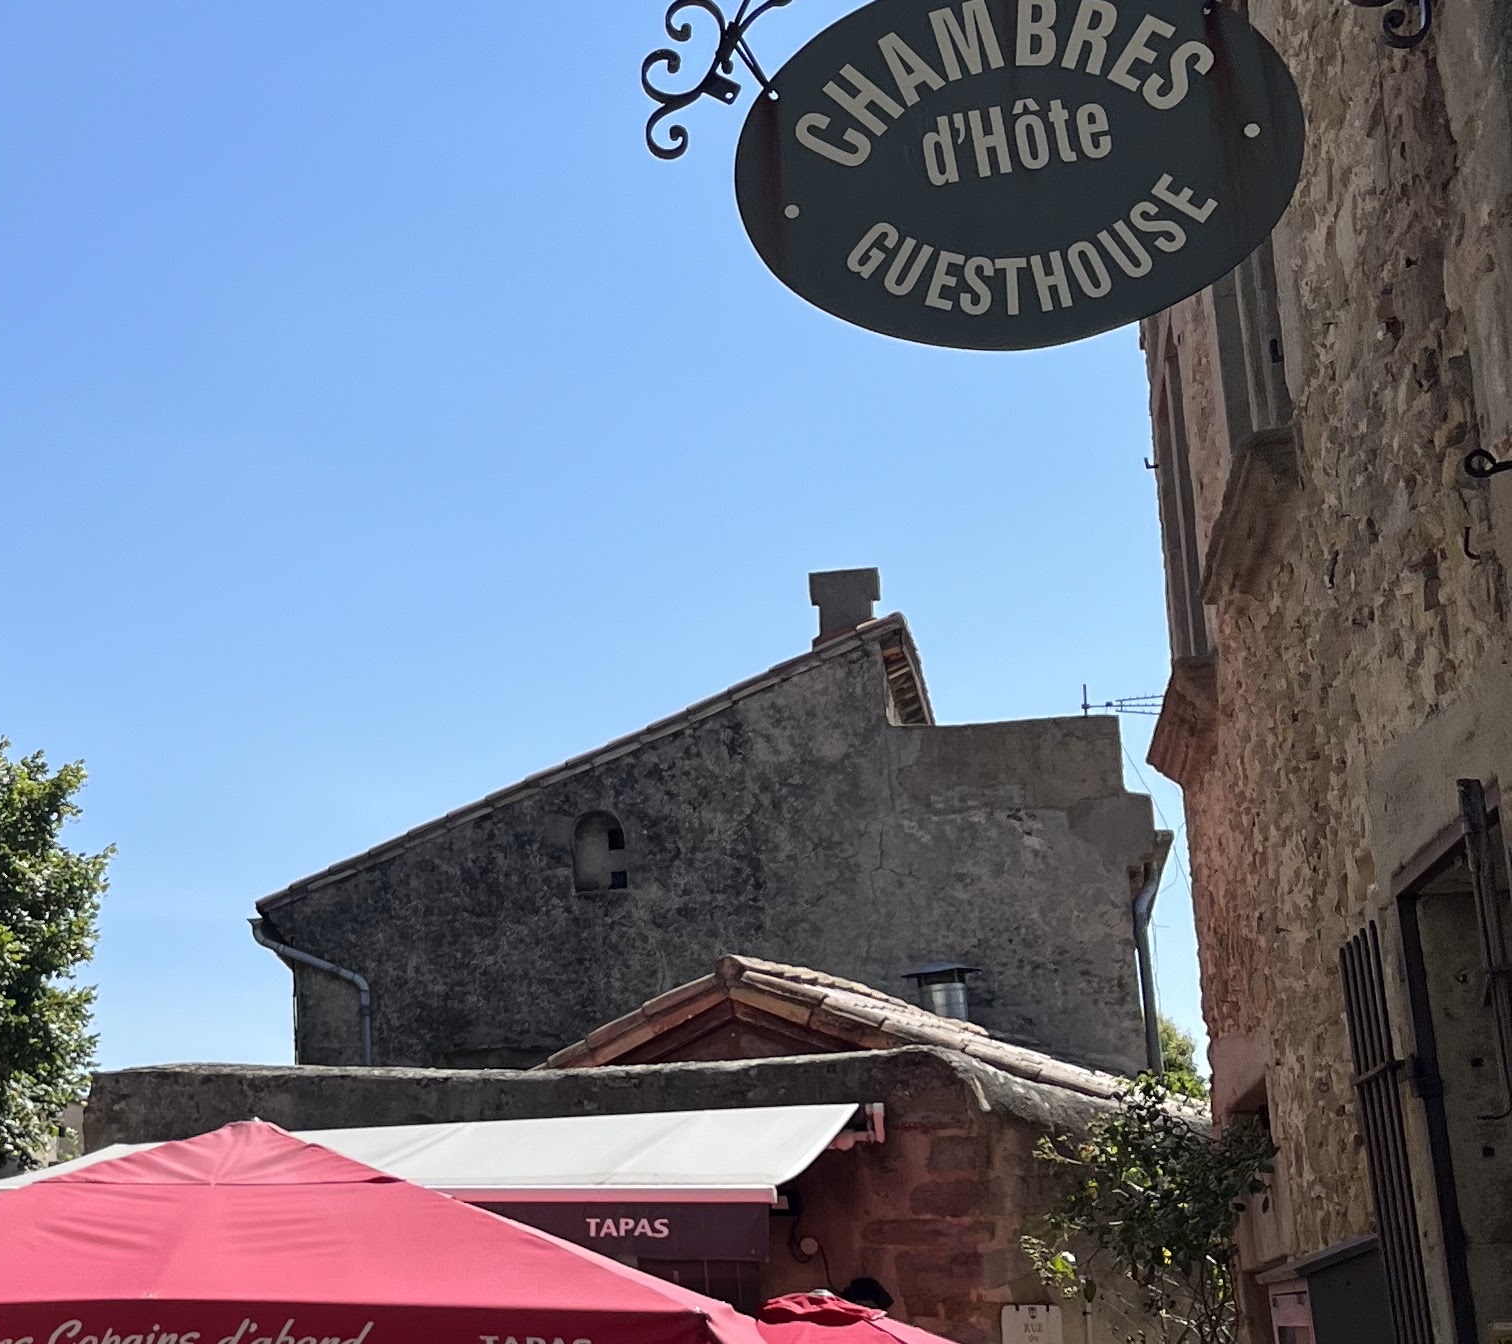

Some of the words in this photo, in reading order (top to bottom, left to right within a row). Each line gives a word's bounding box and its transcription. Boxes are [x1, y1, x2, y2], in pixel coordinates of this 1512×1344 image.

[921, 97, 1113, 187] d'Hôte
[846, 172, 1219, 316] GUESTHOUSE
[585, 1217, 670, 1239] TAPAS
[1023, 1323, 1043, 1334] RUE
